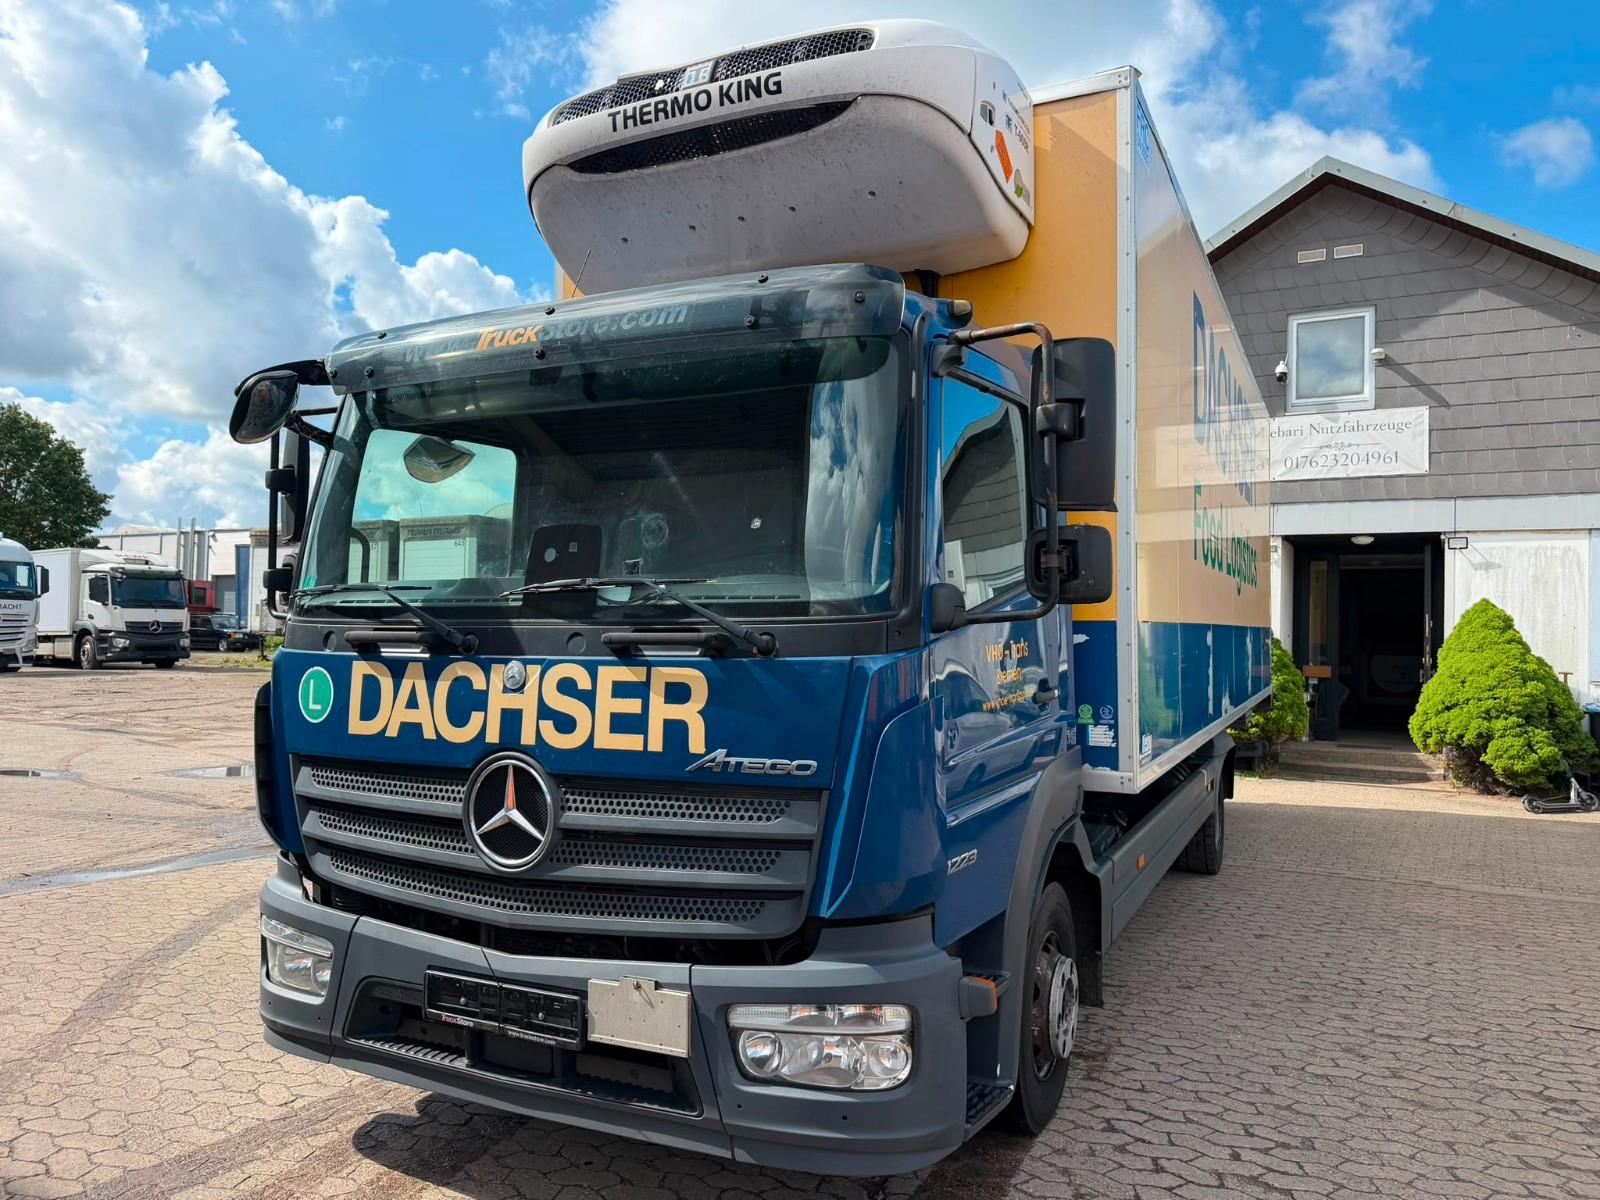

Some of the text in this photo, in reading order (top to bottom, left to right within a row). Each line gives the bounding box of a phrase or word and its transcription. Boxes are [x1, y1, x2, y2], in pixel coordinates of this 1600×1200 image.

[608, 72, 782, 132] THERMO KING
[1270, 420, 1412, 438] ebari Nutzfahrzeuge
[1284, 450, 1399, 470] 017623204961
[348, 660, 709, 754] DACHSER
